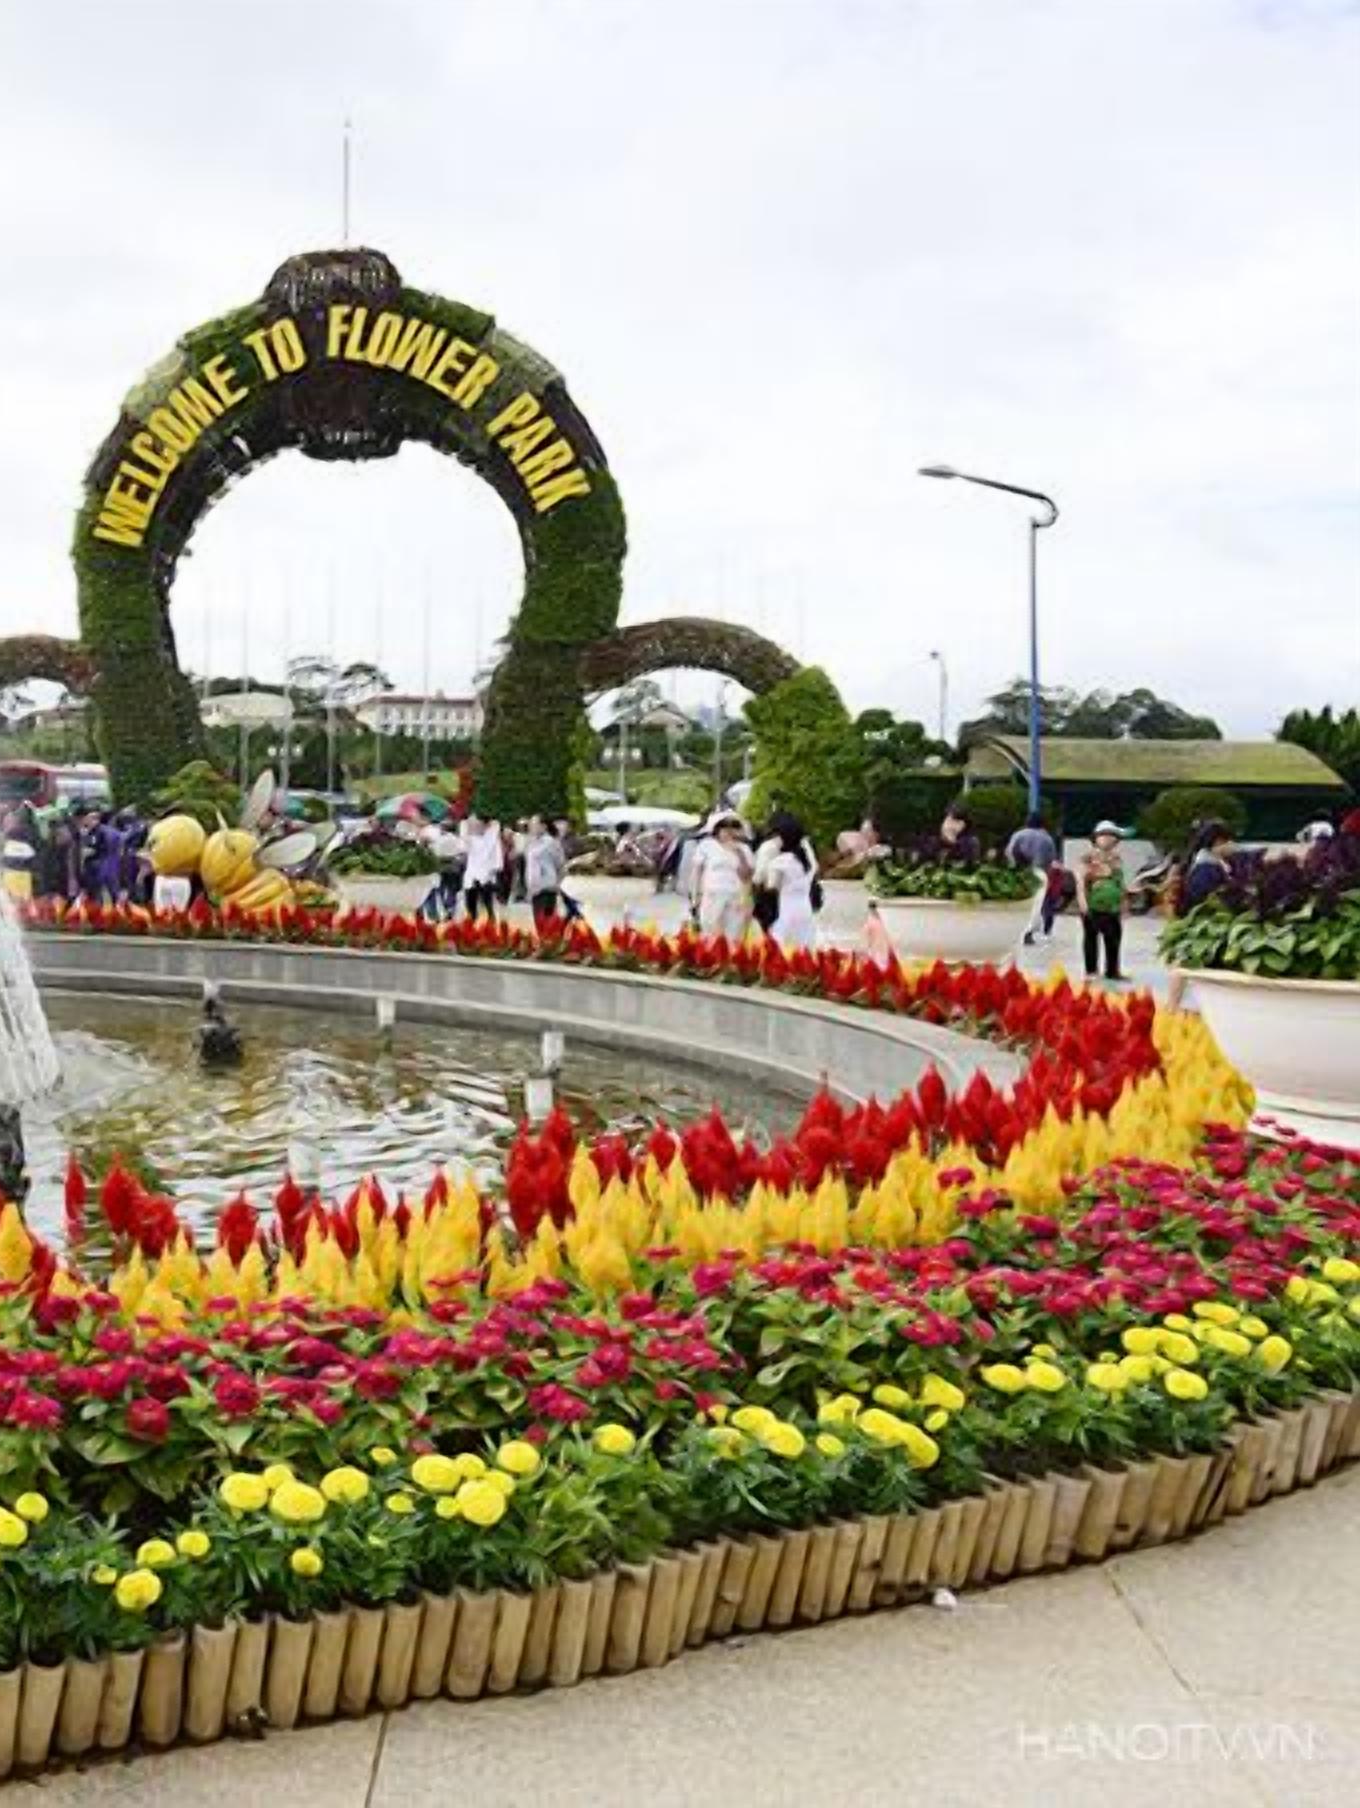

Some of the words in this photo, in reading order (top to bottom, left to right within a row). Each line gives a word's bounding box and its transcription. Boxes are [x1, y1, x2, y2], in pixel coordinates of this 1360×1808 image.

[93, 355, 249, 548] WELCOME
[246, 319, 307, 381] TO
[328, 304, 499, 408] FLOWER
[487, 391, 592, 513] PARK
